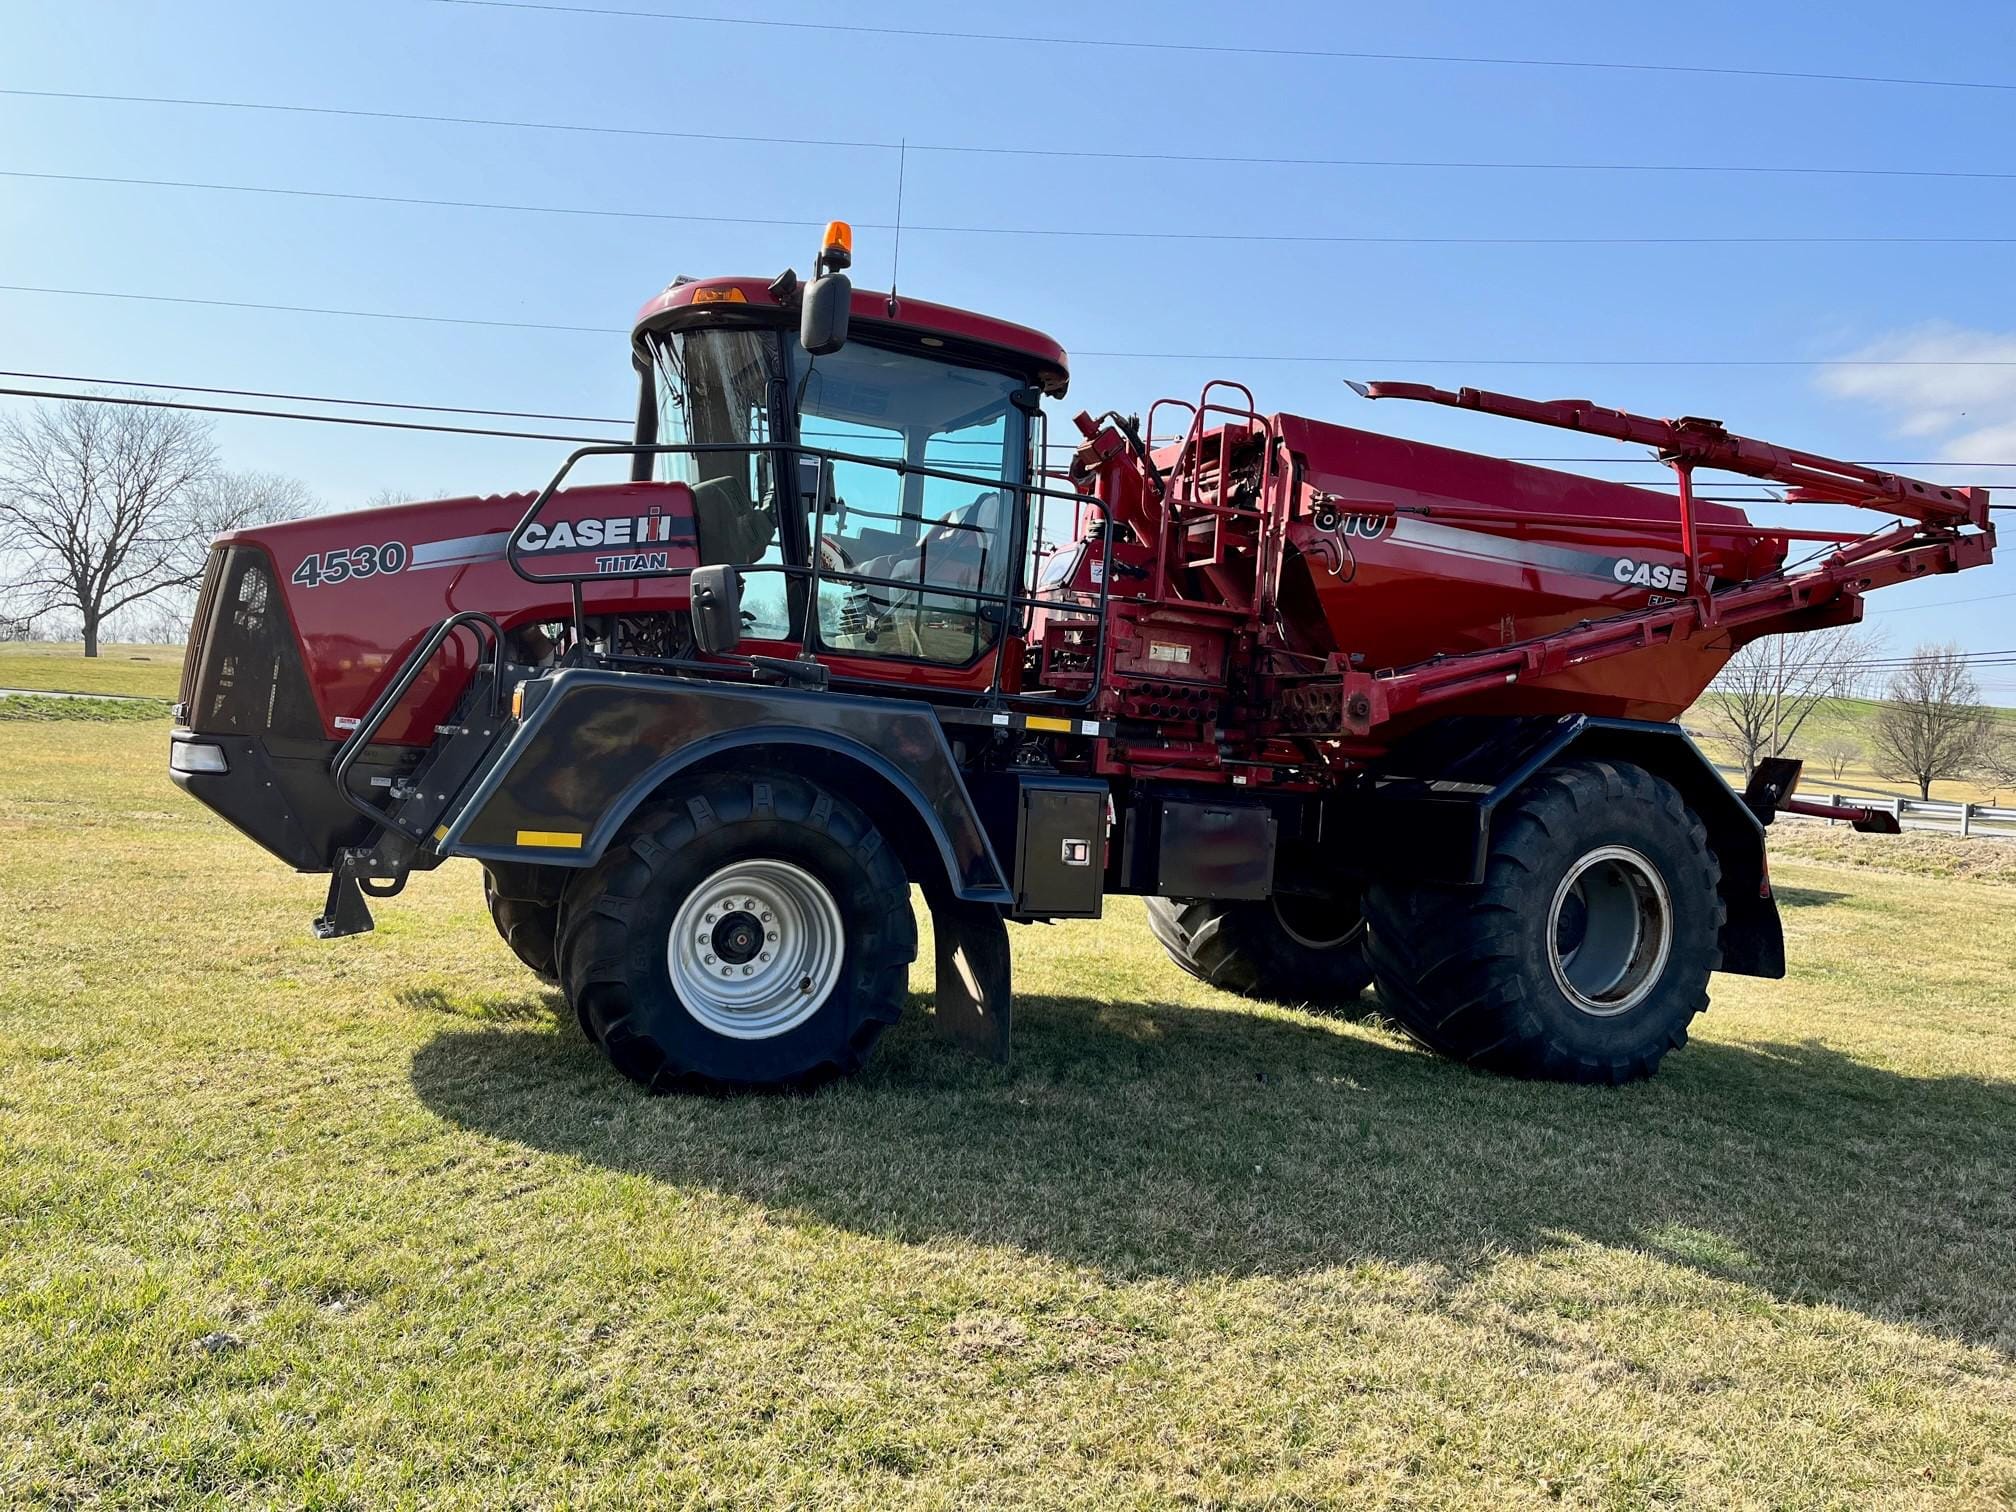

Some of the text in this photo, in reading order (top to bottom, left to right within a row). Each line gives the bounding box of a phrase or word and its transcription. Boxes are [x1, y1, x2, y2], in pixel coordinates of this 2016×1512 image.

[517, 506, 671, 551] CASE IH
[291, 541, 407, 588] 4530
[595, 552, 668, 573] TITAN
[1613, 558, 1688, 593] CASE
